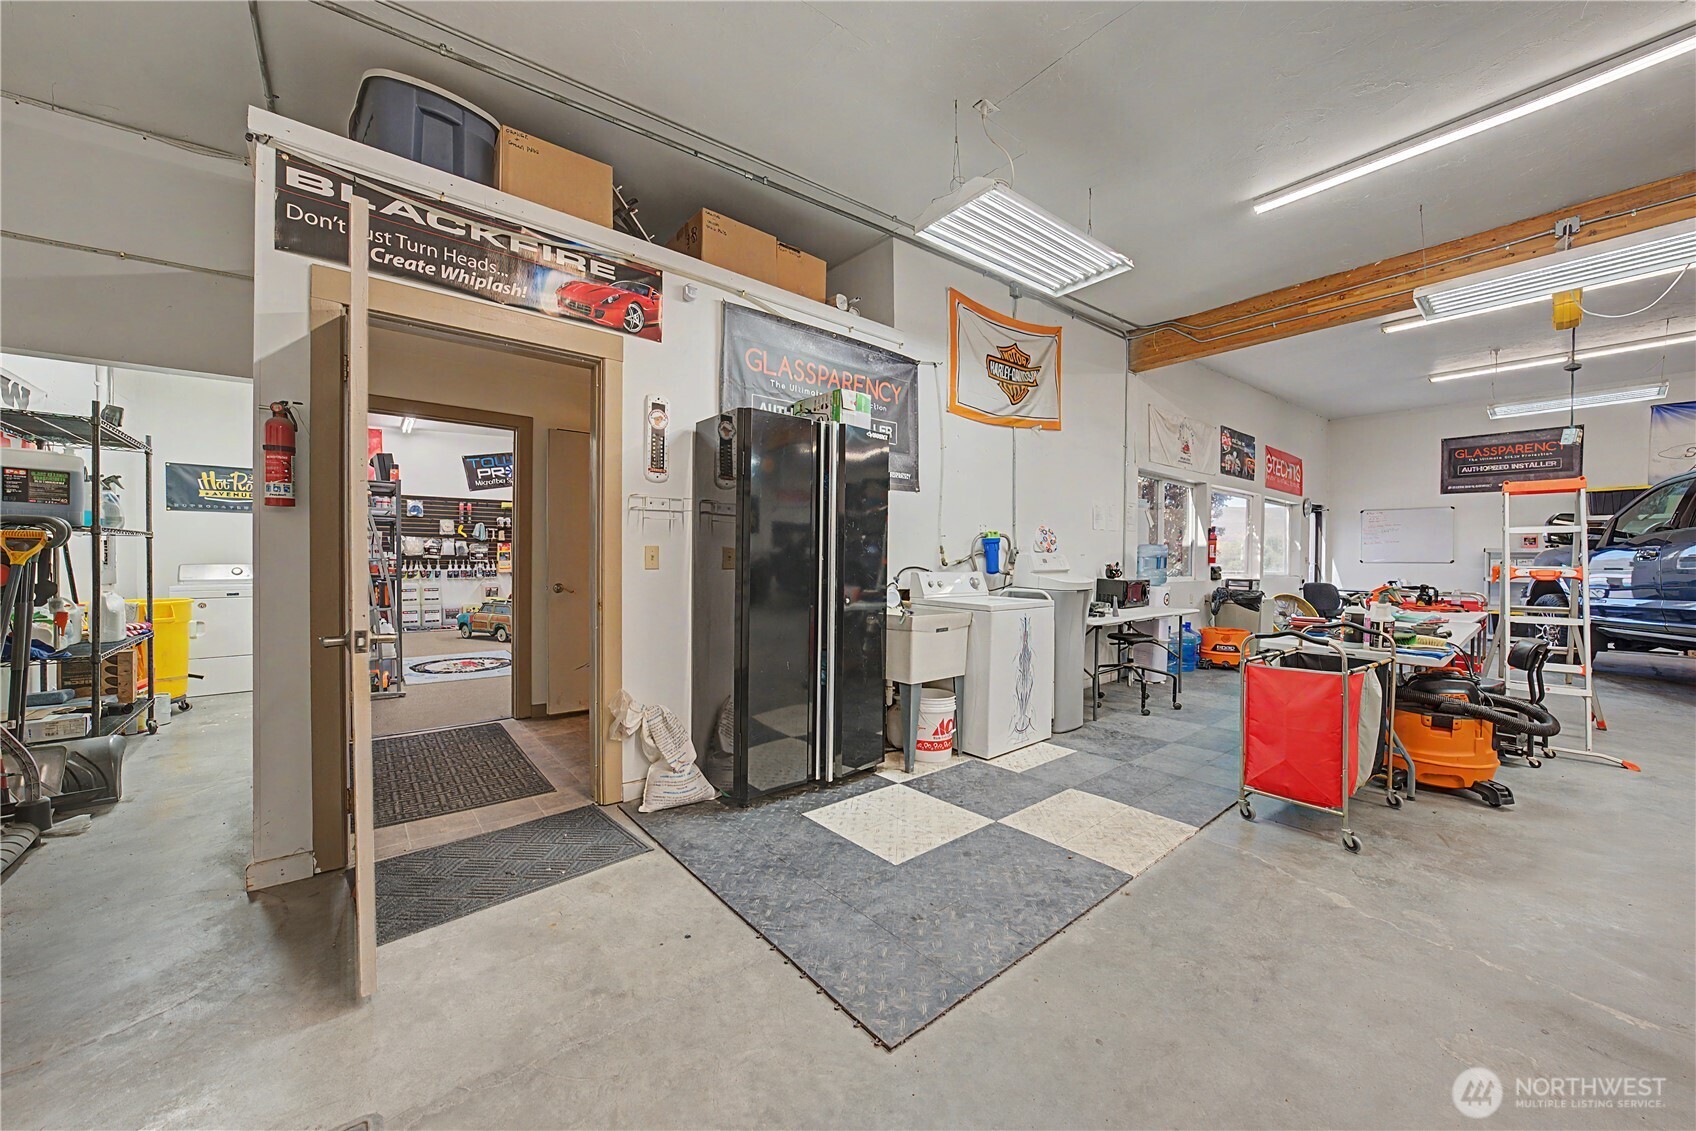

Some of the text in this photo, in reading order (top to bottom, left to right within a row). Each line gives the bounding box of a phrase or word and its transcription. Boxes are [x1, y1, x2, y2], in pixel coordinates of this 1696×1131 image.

[285, 165, 616, 281] BLACKFIRE
[285, 203, 347, 234] Don't
[394, 233, 438, 259] Turn
[443, 246, 509, 278] Heads...
[369, 247, 528, 299] Create Whiplash!
[744, 347, 902, 405] GLASSPARENCY
[770, 379, 786, 390] The
[1455, 441, 1564, 459] GLASSPARENCY
[1461, 460, 1557, 473] AUTHORIZED INSTALLER
[197, 470, 253, 492] Hot Ro
